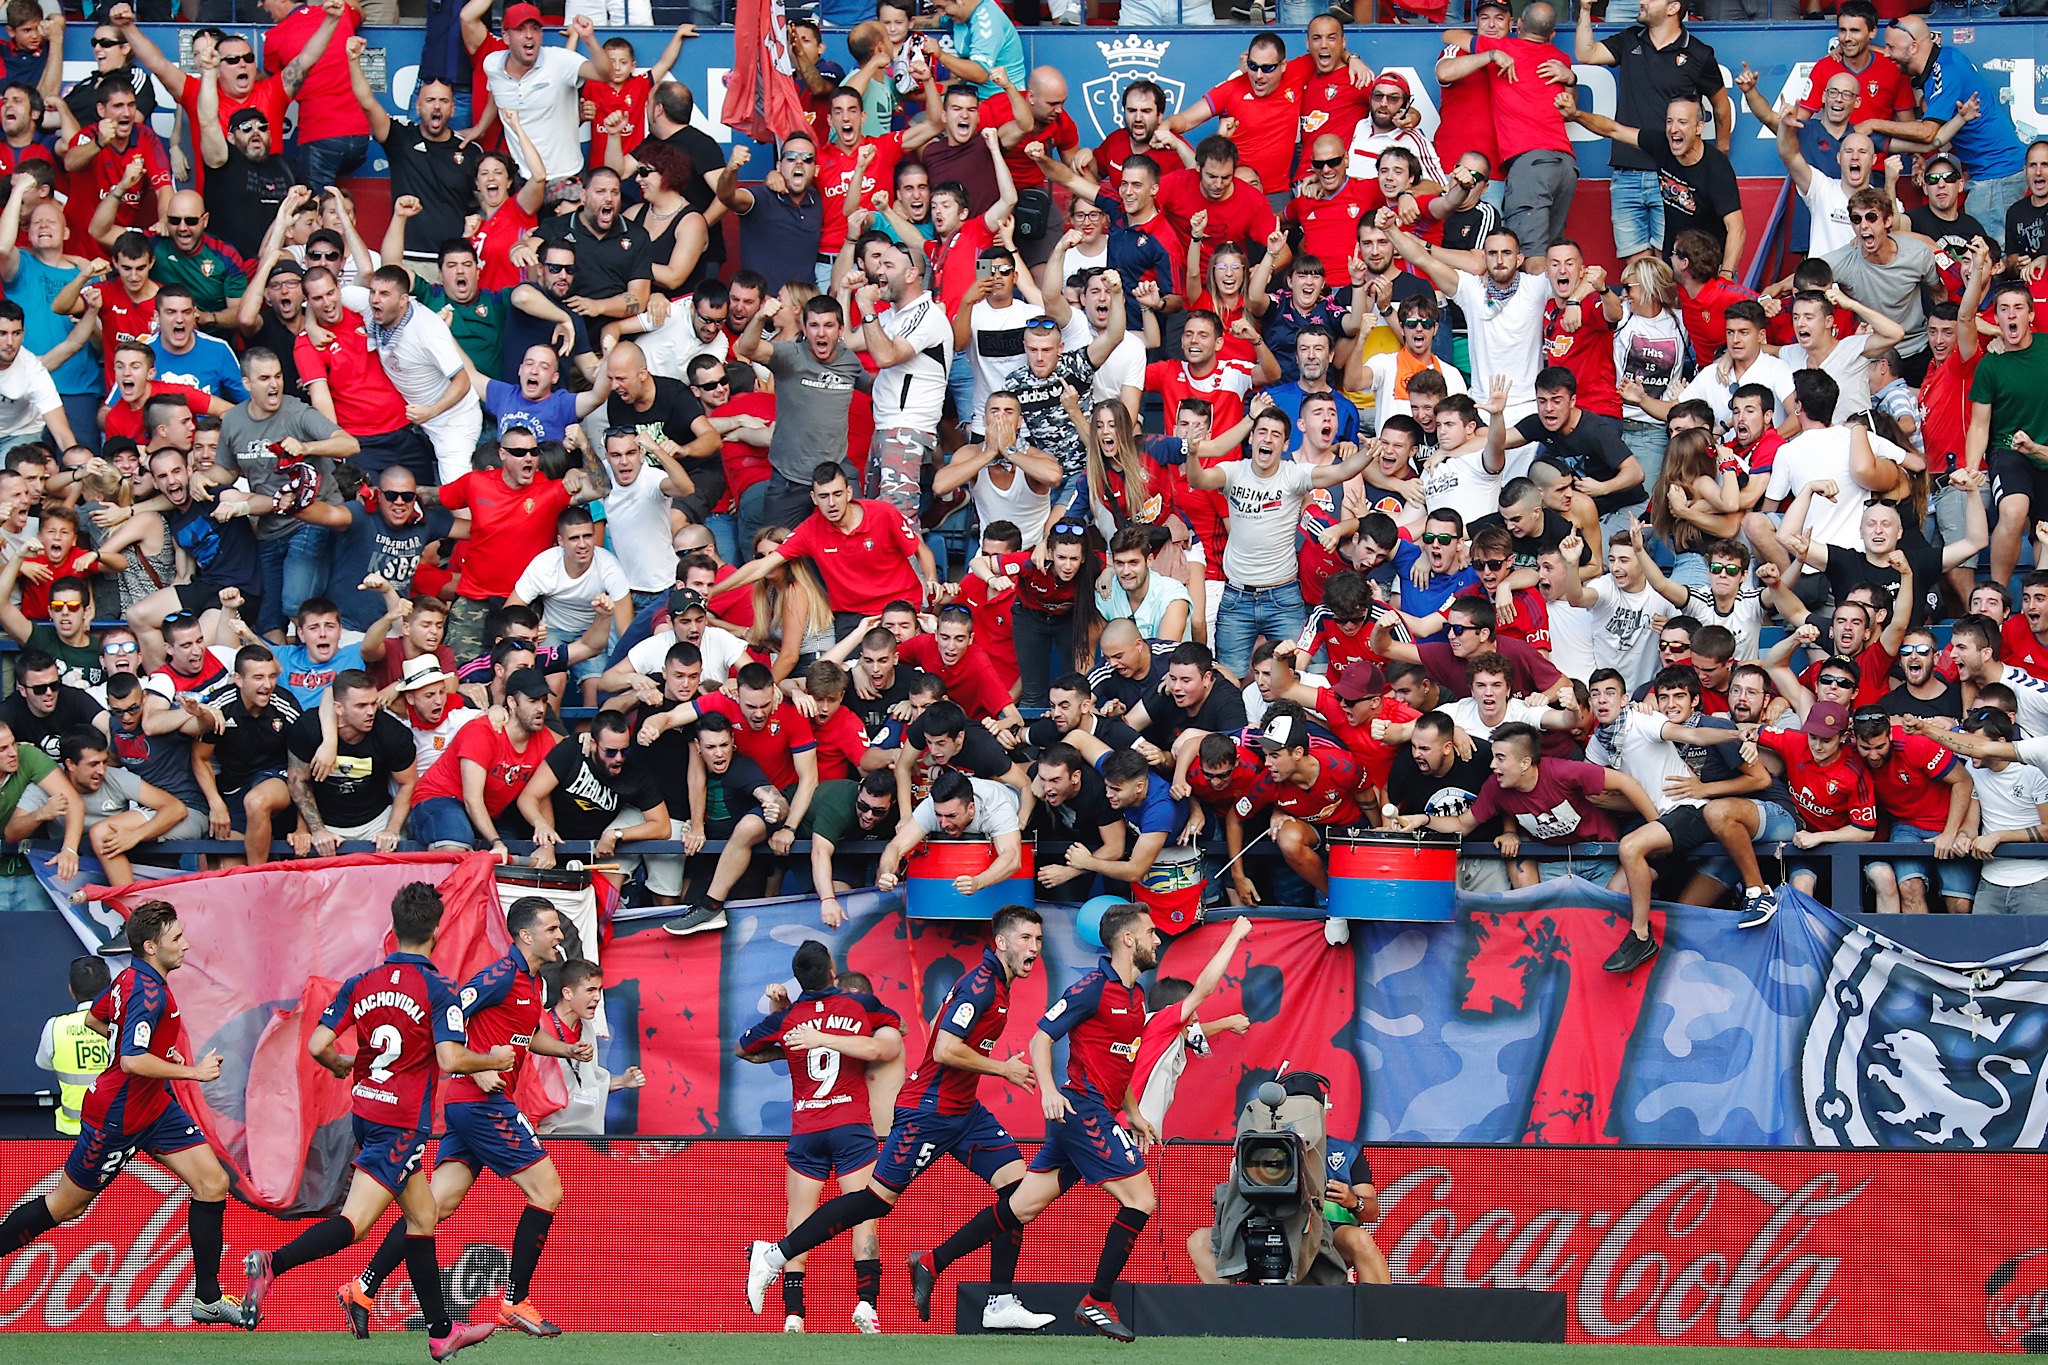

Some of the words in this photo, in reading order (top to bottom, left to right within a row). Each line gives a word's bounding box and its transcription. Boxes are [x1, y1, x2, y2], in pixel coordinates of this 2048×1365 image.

[1642, 347, 1664, 358] THIS
[1644, 362, 1656, 372] IS
[1639, 375, 1669, 386] SADAR
[1230, 486, 1282, 502] ORIGINALS
[1238, 502, 1261, 513] J&J
[1687, 749, 1708, 757] REAMS
[353, 991, 427, 1024] NACHOVIDAL
[826, 1014, 863, 1035] ÁVILA
[368, 1024, 403, 1084] 2
[807, 1047, 841, 1098] 9
[405, 1143, 427, 1172] 2
[915, 1143, 937, 1167] 5
